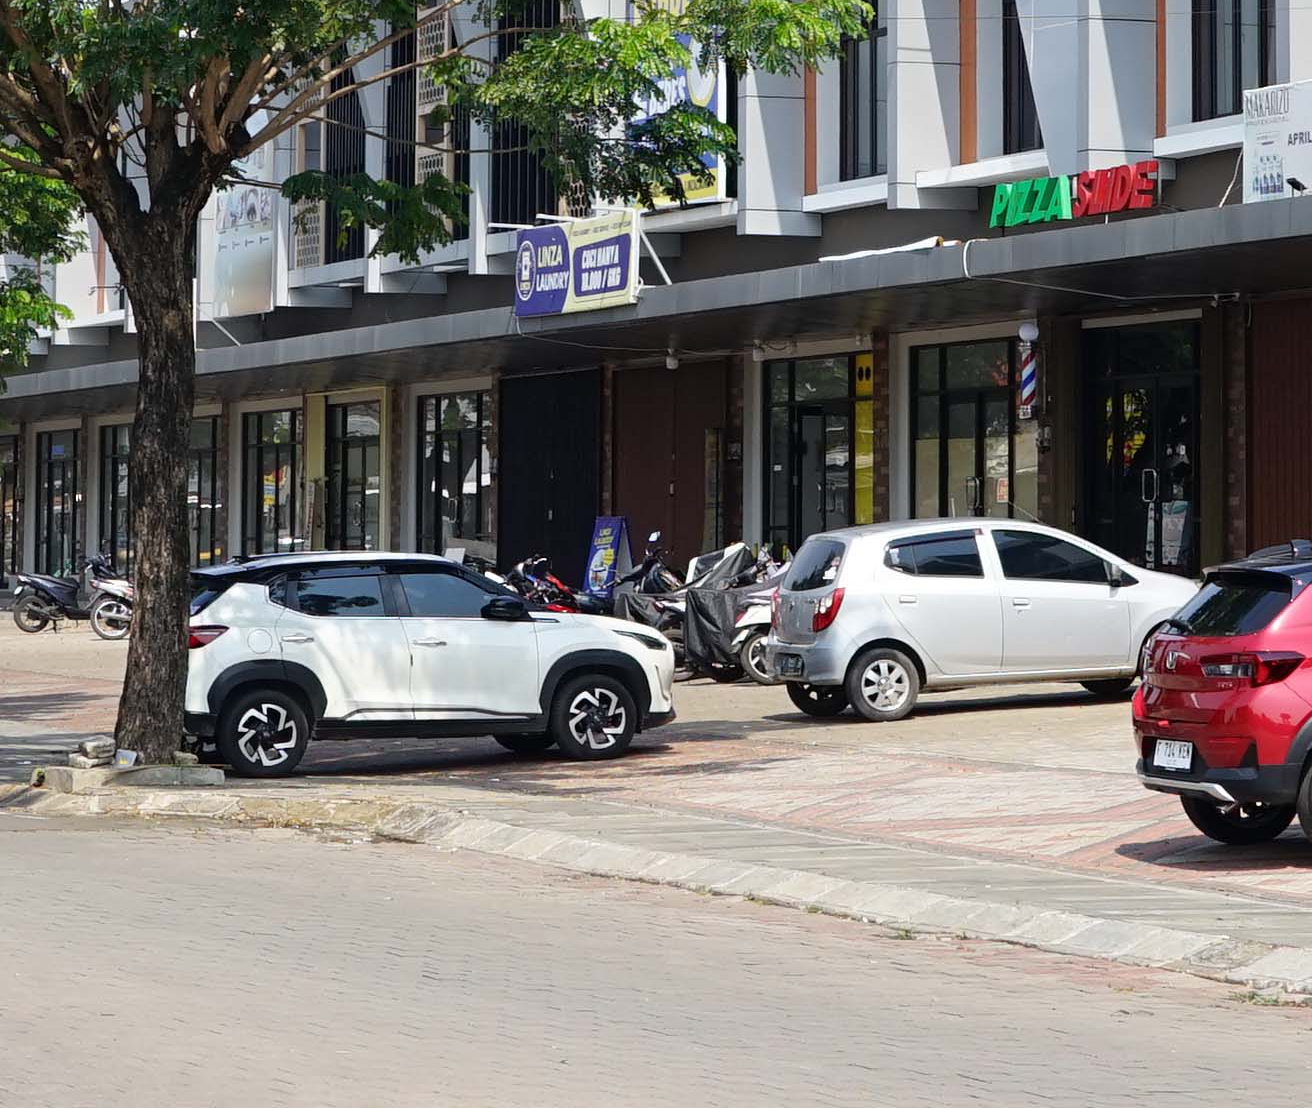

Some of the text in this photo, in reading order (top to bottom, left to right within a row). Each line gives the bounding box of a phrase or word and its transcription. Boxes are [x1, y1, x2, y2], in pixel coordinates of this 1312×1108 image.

[989, 160, 1159, 229] PIZZA SLIDE
[538, 244, 563, 268] LINZA
[536, 270, 570, 292] LAUNDRY
